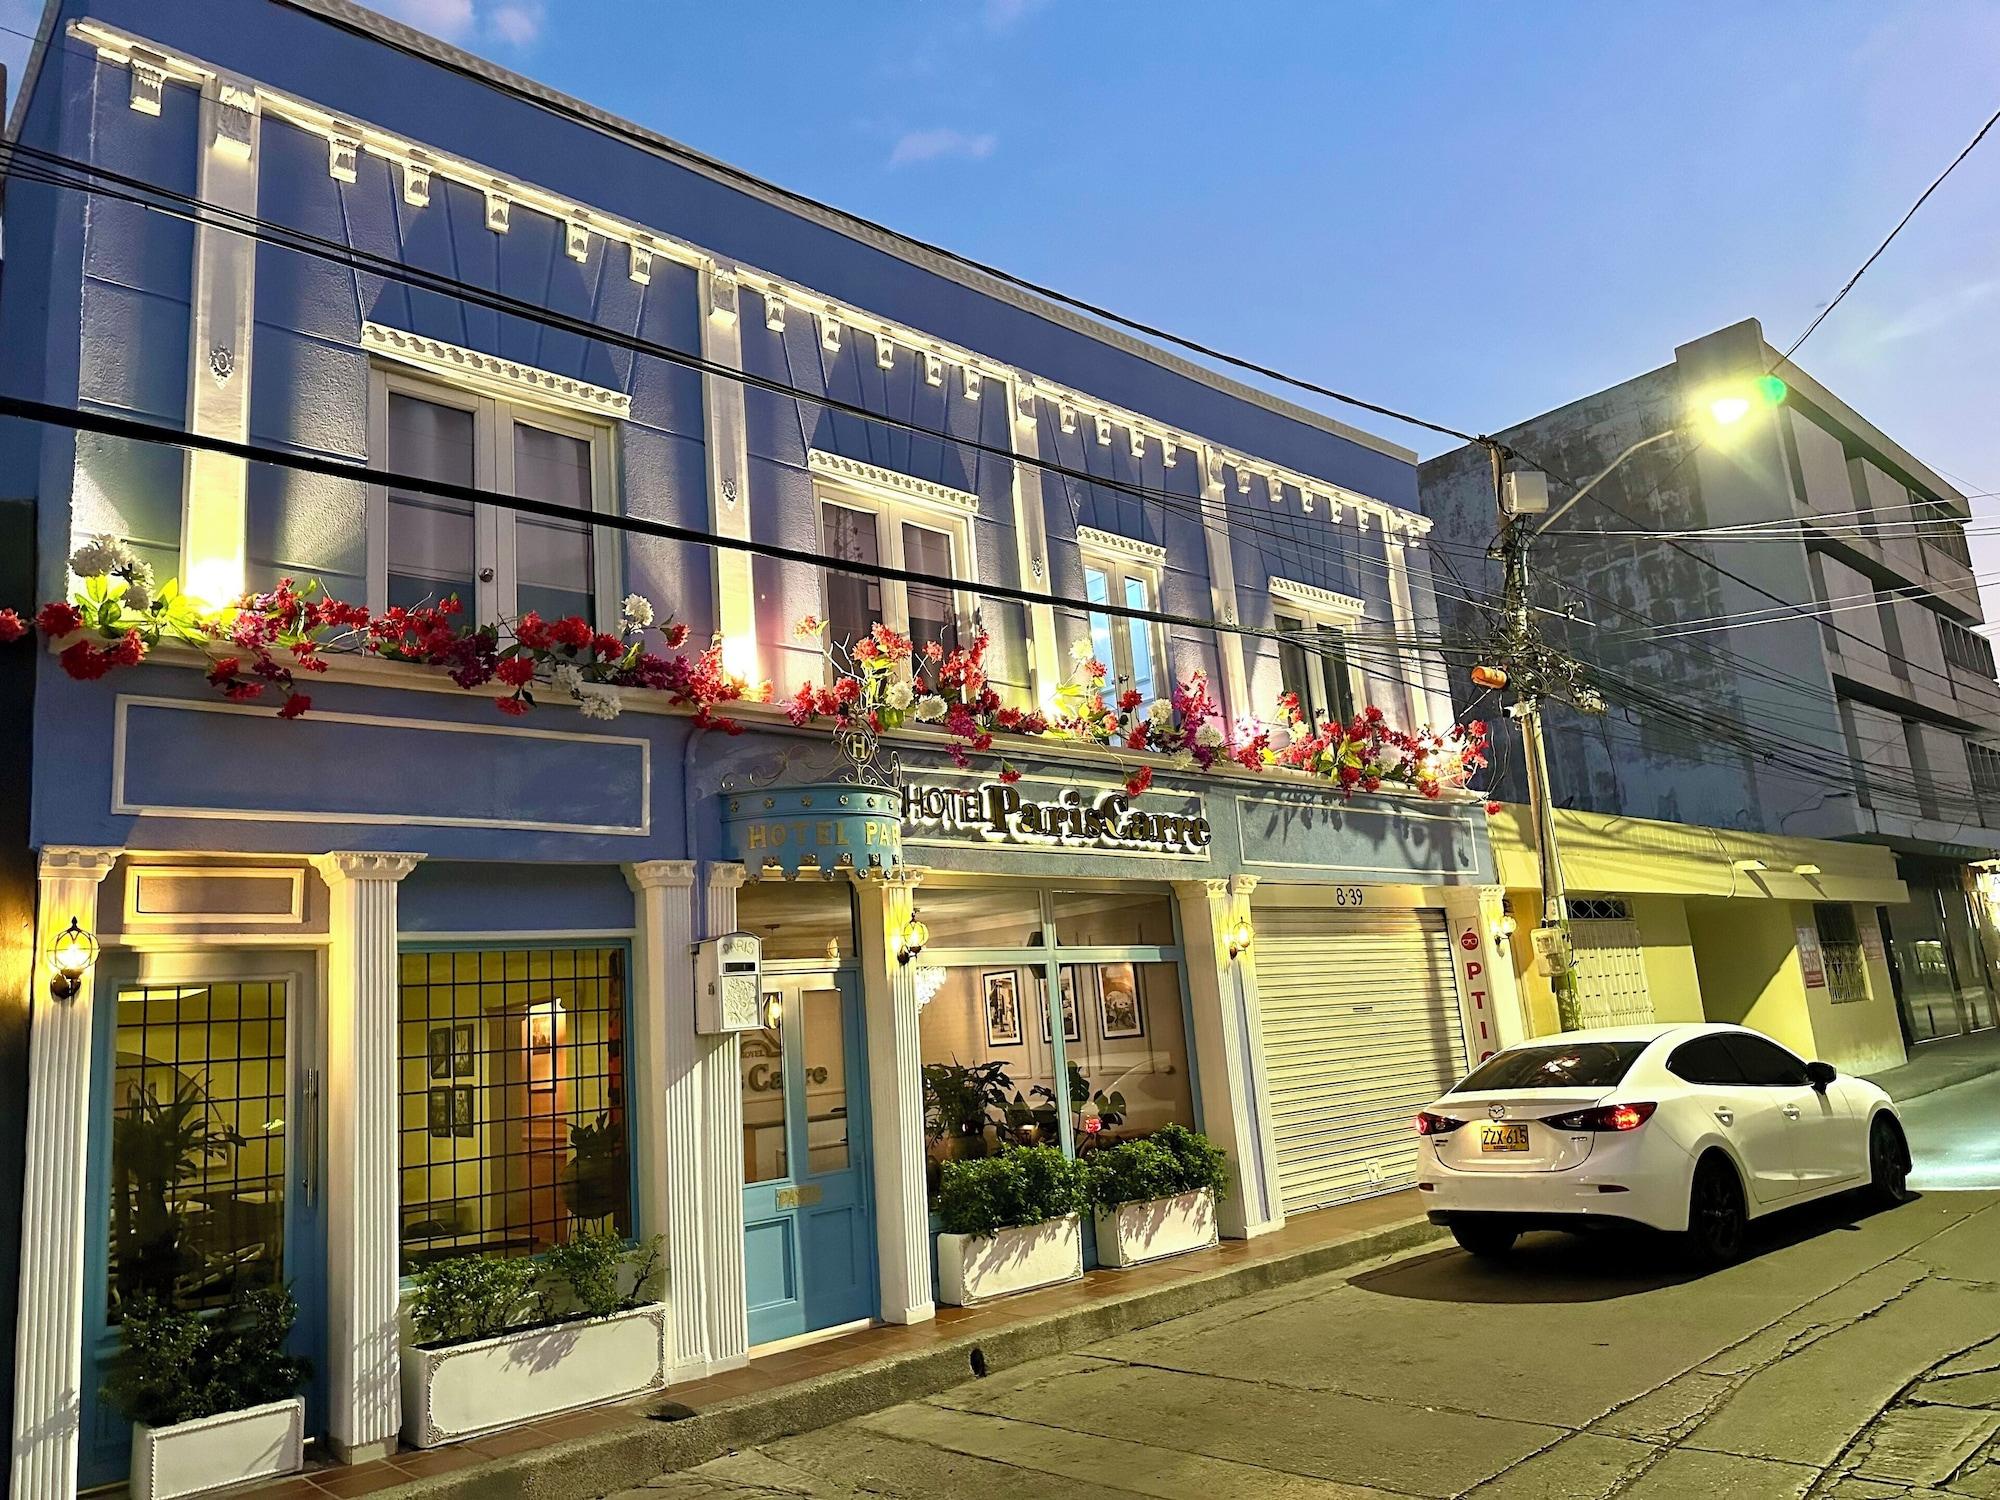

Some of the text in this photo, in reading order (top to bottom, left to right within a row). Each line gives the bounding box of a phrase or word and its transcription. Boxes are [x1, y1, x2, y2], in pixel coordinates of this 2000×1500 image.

[901, 786, 991, 823] HOTEL
[749, 820, 849, 849] HOTEL
[722, 939, 755, 955] PARIS
[1506, 1129, 1527, 1144] 615
